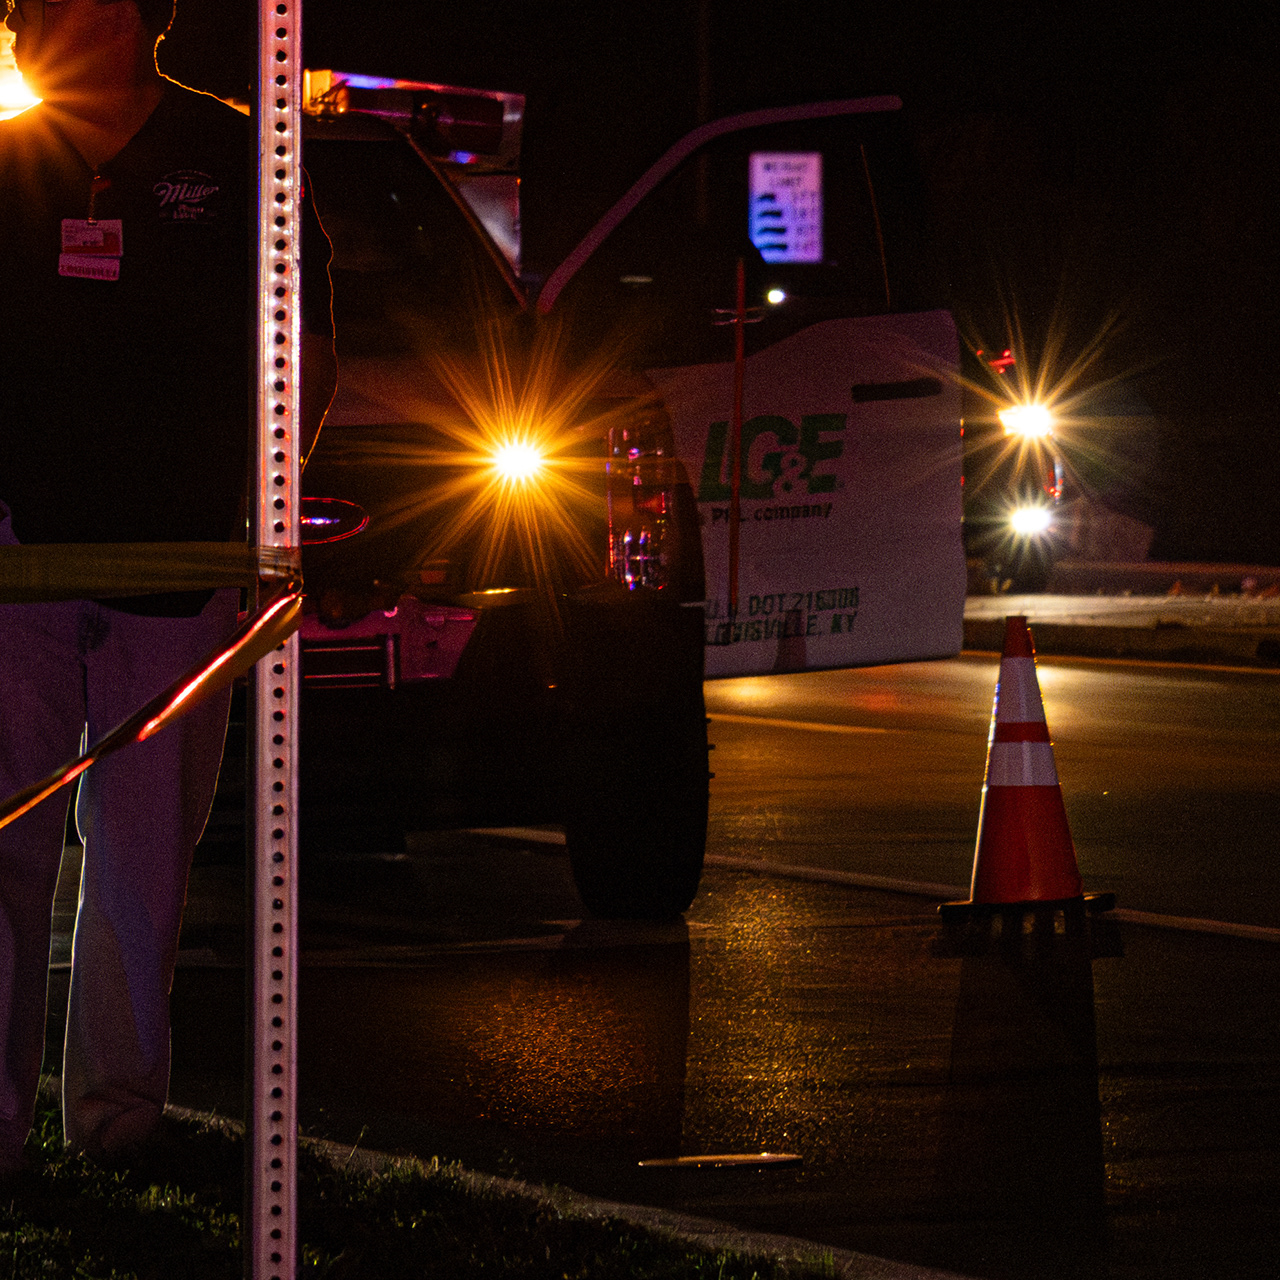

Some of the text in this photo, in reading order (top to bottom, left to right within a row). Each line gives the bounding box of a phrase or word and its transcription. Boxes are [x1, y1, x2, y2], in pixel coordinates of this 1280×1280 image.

[153, 182, 219, 207] Miller
[697, 413, 847, 502] LG&E
[754, 503, 832, 521] company
[749, 593, 786, 616] DOT
[831, 611, 858, 633] KY
